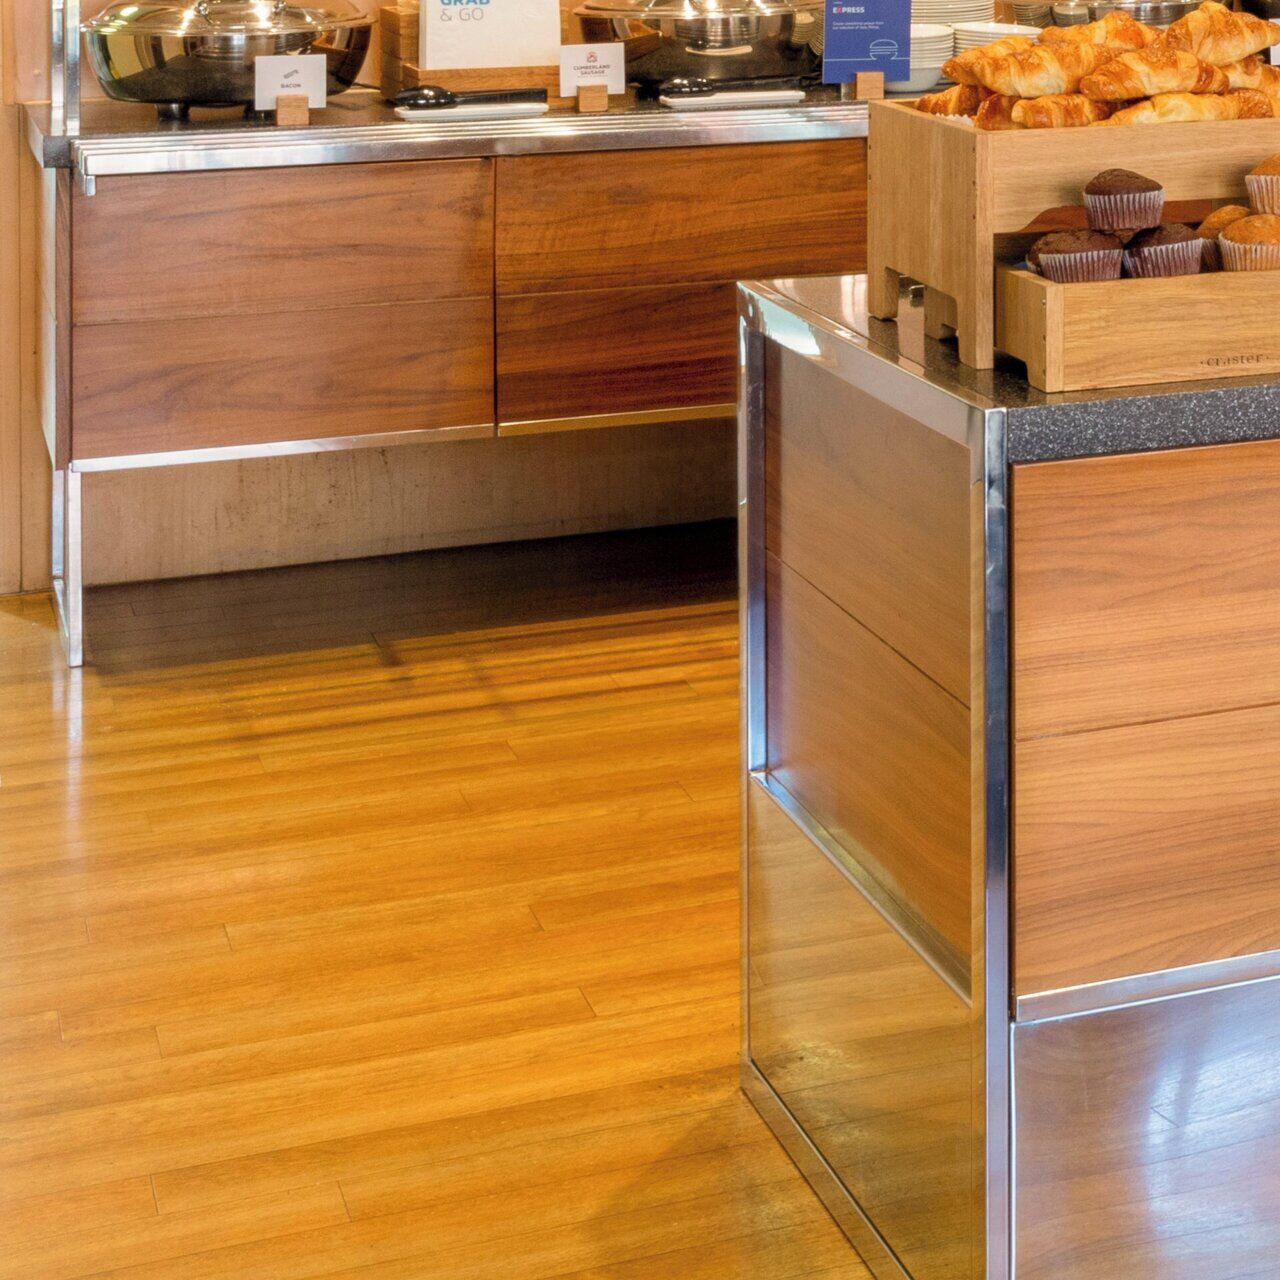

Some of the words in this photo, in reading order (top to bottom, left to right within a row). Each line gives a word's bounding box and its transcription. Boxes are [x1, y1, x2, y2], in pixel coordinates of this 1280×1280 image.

[440, 8, 453, 22] &
[459, 7, 484, 21] GO
[832, 6, 865, 14] EXPRESS
